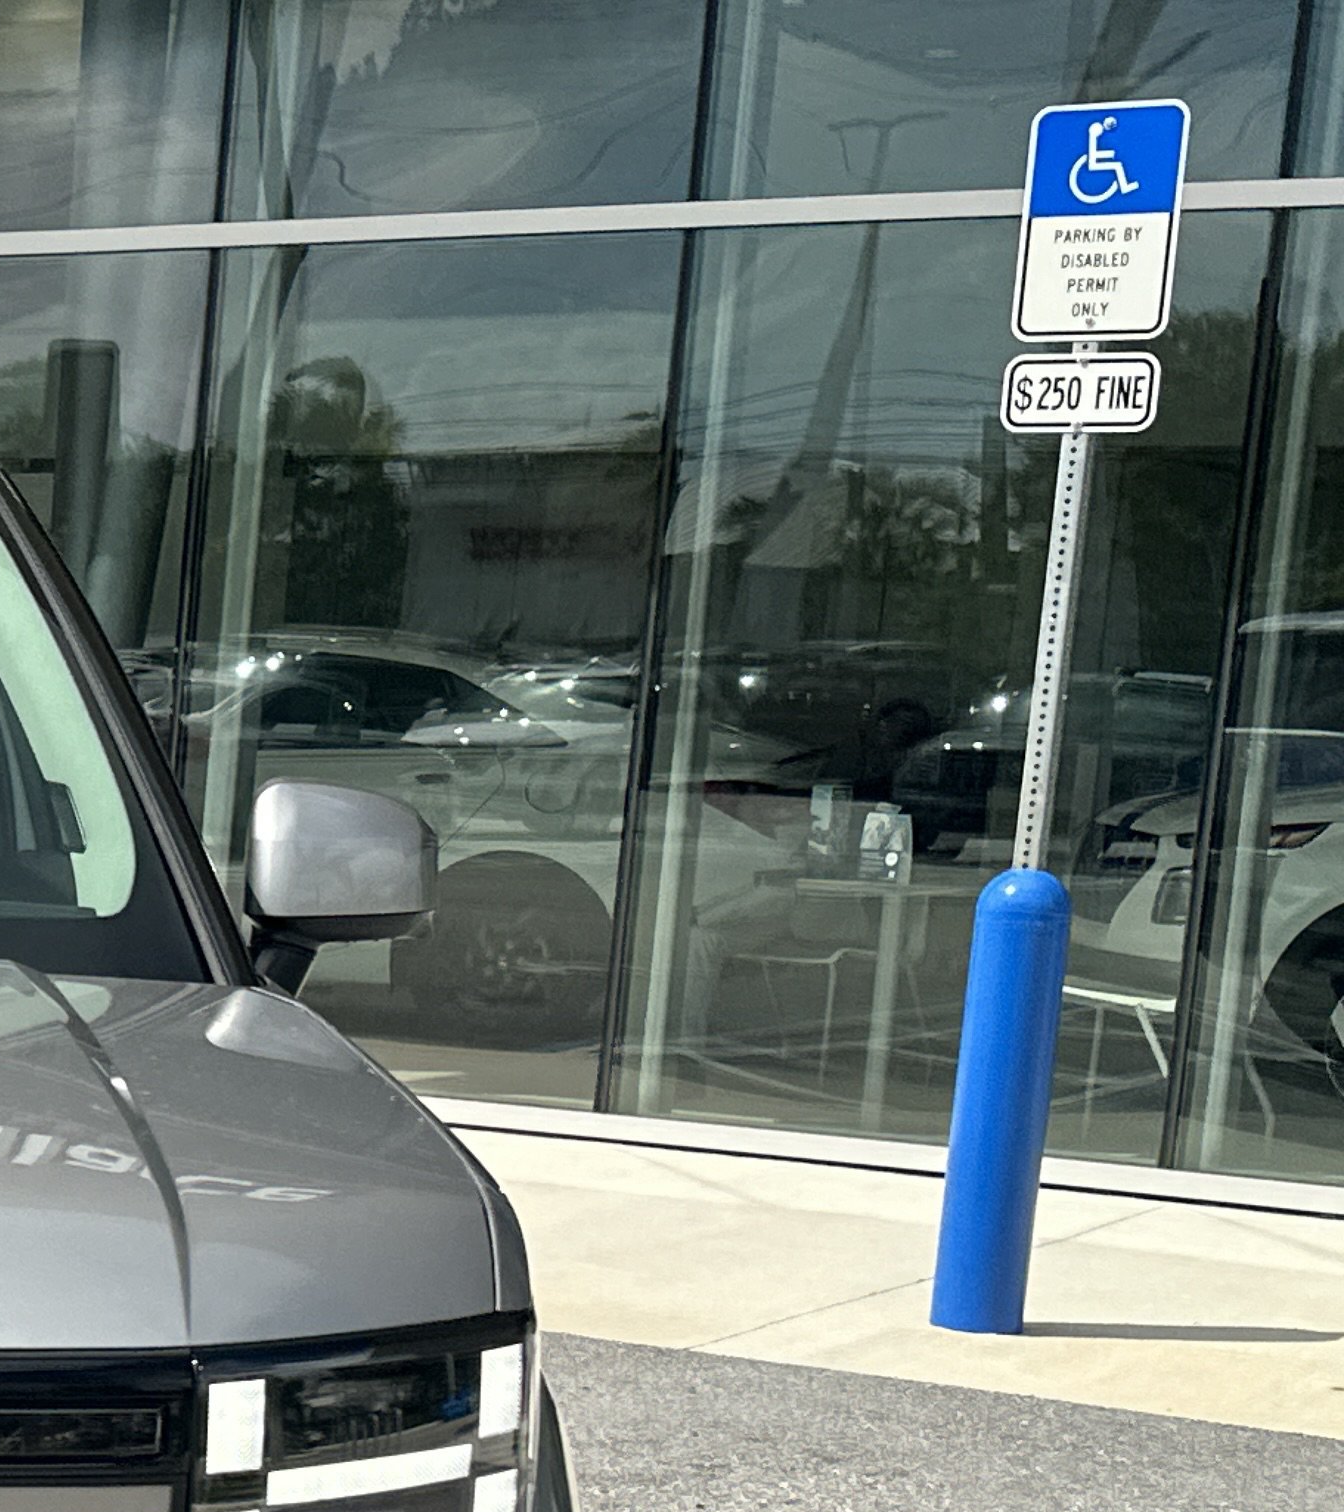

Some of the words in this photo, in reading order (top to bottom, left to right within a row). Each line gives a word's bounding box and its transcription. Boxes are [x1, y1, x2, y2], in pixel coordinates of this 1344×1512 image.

[1054, 228, 1116, 244] PARKING
[1124, 227, 1143, 242] BY
[1061, 252, 1130, 269] DISABLED
[1066, 277, 1119, 293] PERMIT
[1071, 302, 1110, 318] ONLY
[1014, 373, 1082, 415] $250
[1094, 375, 1147, 410] FINE
